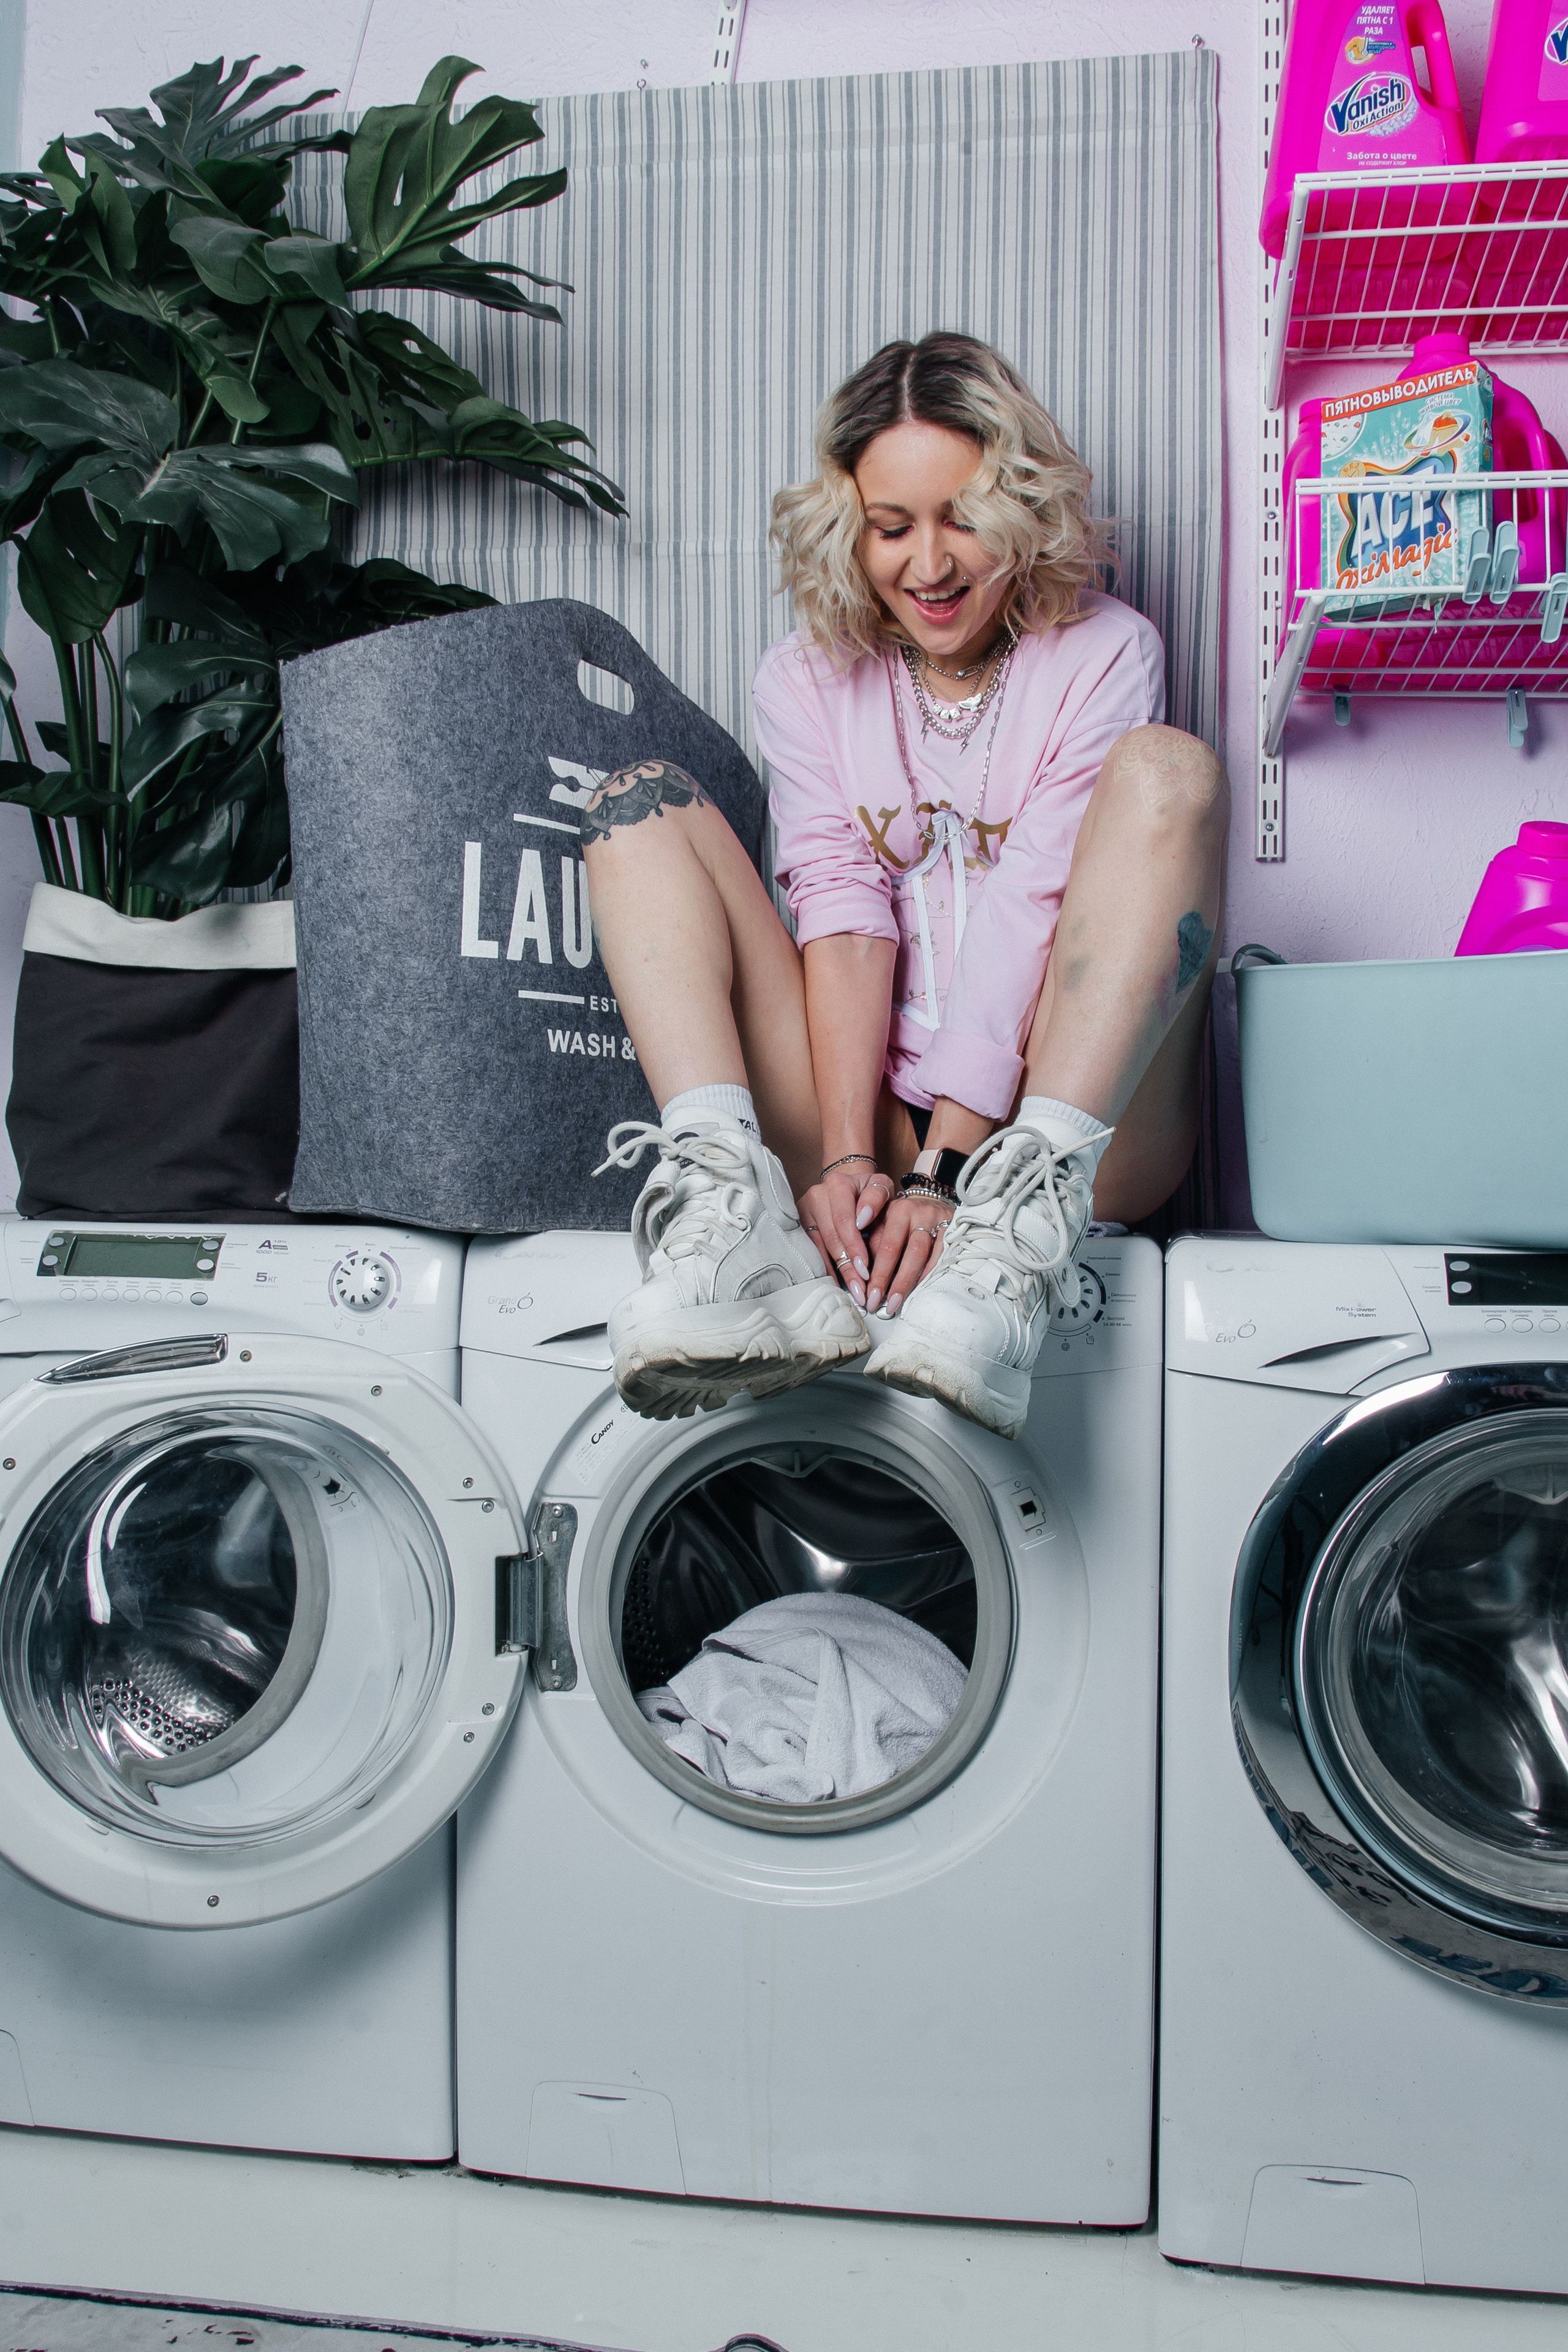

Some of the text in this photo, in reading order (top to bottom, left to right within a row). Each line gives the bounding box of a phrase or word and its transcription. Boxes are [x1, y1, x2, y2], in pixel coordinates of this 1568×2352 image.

[1361, 6, 1395, 16] УДАЛЯЕТ
[1356, 16, 1393, 25] ПЯТНА С 1
[1364, 26, 1383, 35] РАЗА
[1330, 73, 1403, 134] Vanish
[1352, 102, 1401, 130] Oxi Action
[1346, 151, 1381, 160] Забота
[1325, 368, 1474, 418] ПЯТНОВЫВОДИТЕЛЬ
[1425, 393, 1453, 404] СИСТЕМА
[1419, 400, 1443, 414] ЖИВОЙ
[1351, 465, 1434, 558] ACE
[461, 841, 592, 968] LAU
[547, 1028, 636, 1061] WASH &
[499, 1305, 516, 1314] Evo
[1215, 1333, 1236, 1343] Evo
